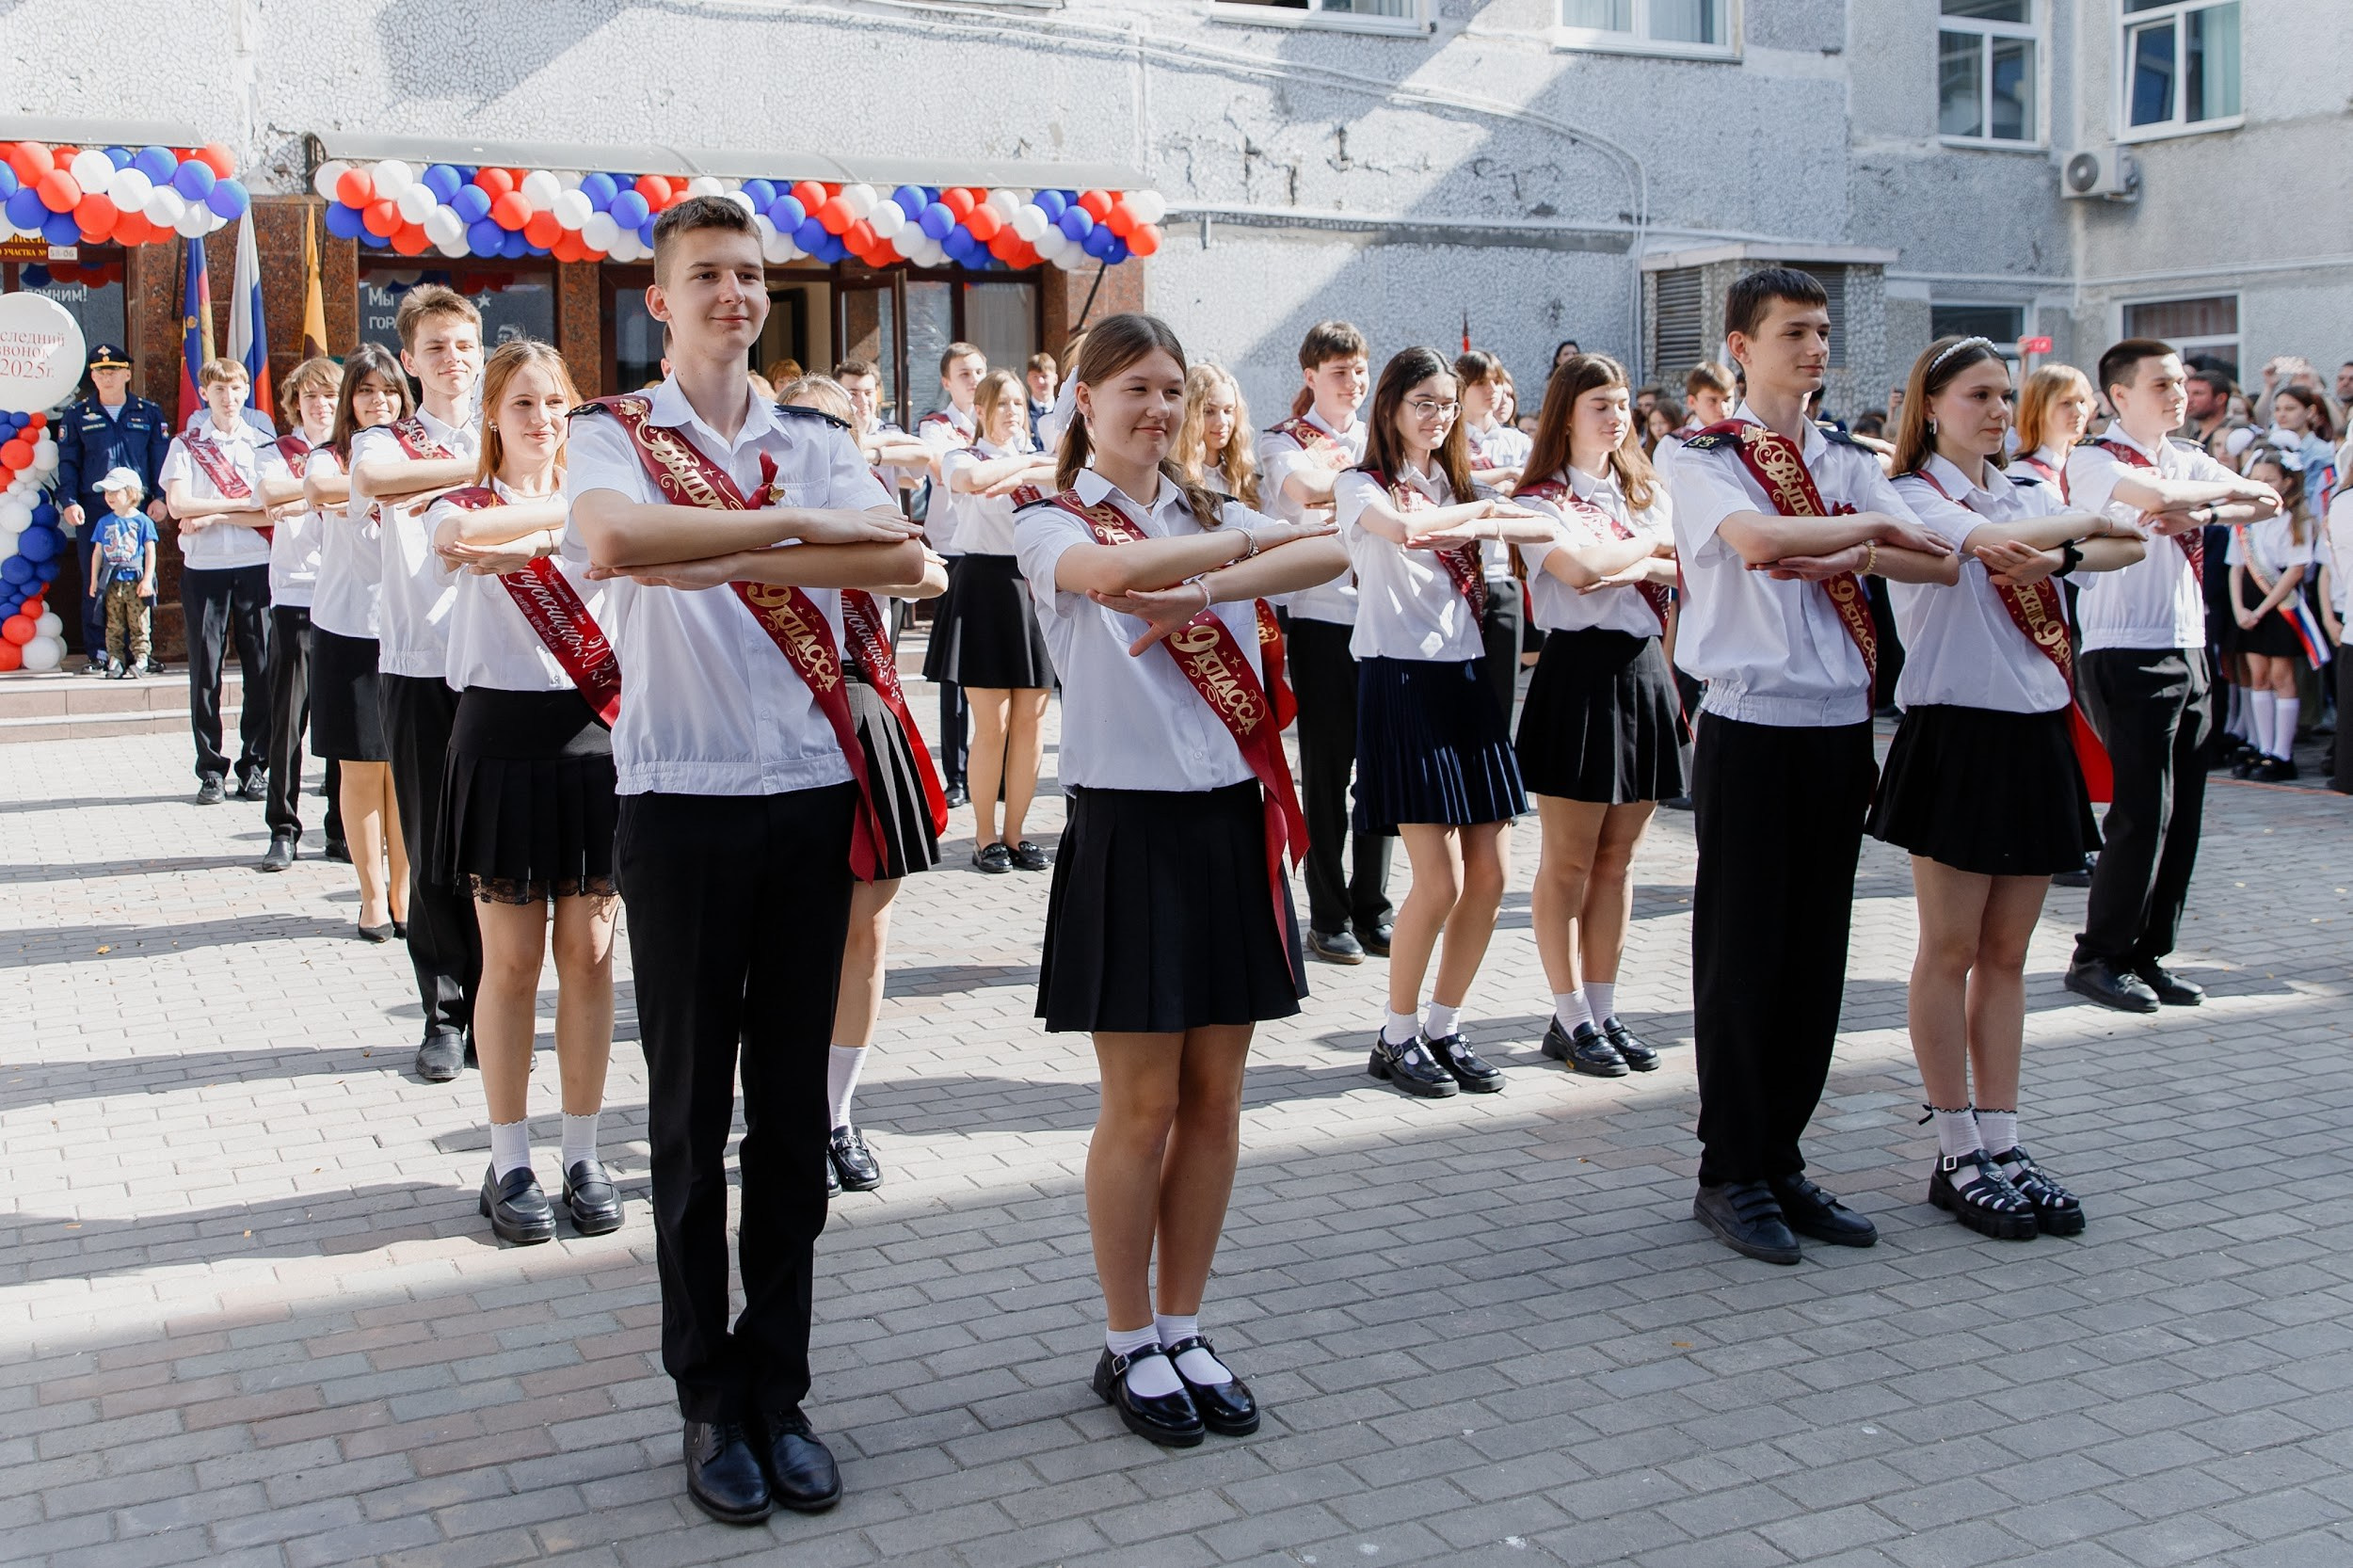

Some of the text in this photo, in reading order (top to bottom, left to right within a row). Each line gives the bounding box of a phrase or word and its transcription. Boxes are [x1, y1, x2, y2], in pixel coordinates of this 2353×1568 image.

[369, 286, 393, 307] Мы
[0, 345, 51, 360] вонок
[769, 605, 838, 692] КЛАССА
[1170, 625, 1259, 736] 9 КЛАССА
